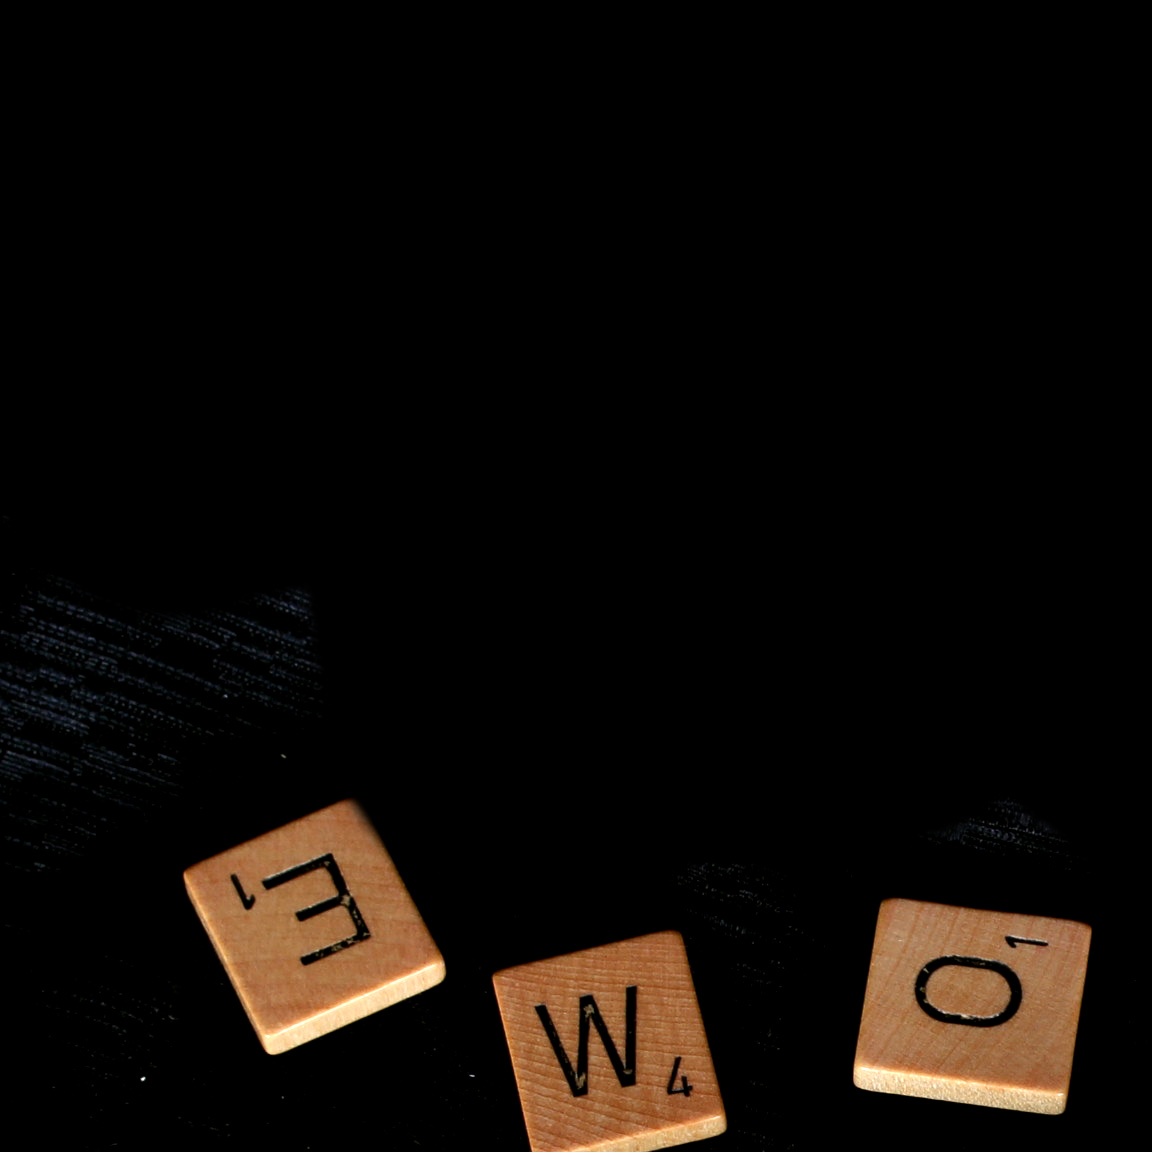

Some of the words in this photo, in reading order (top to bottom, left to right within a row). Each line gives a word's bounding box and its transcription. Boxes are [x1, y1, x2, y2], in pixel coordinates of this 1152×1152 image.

[229, 873, 257, 911] 1
[913, 954, 1024, 1029] O
[1004, 935, 1049, 949] 1
[533, 984, 639, 1099] W
[665, 1056, 694, 1098] 4
